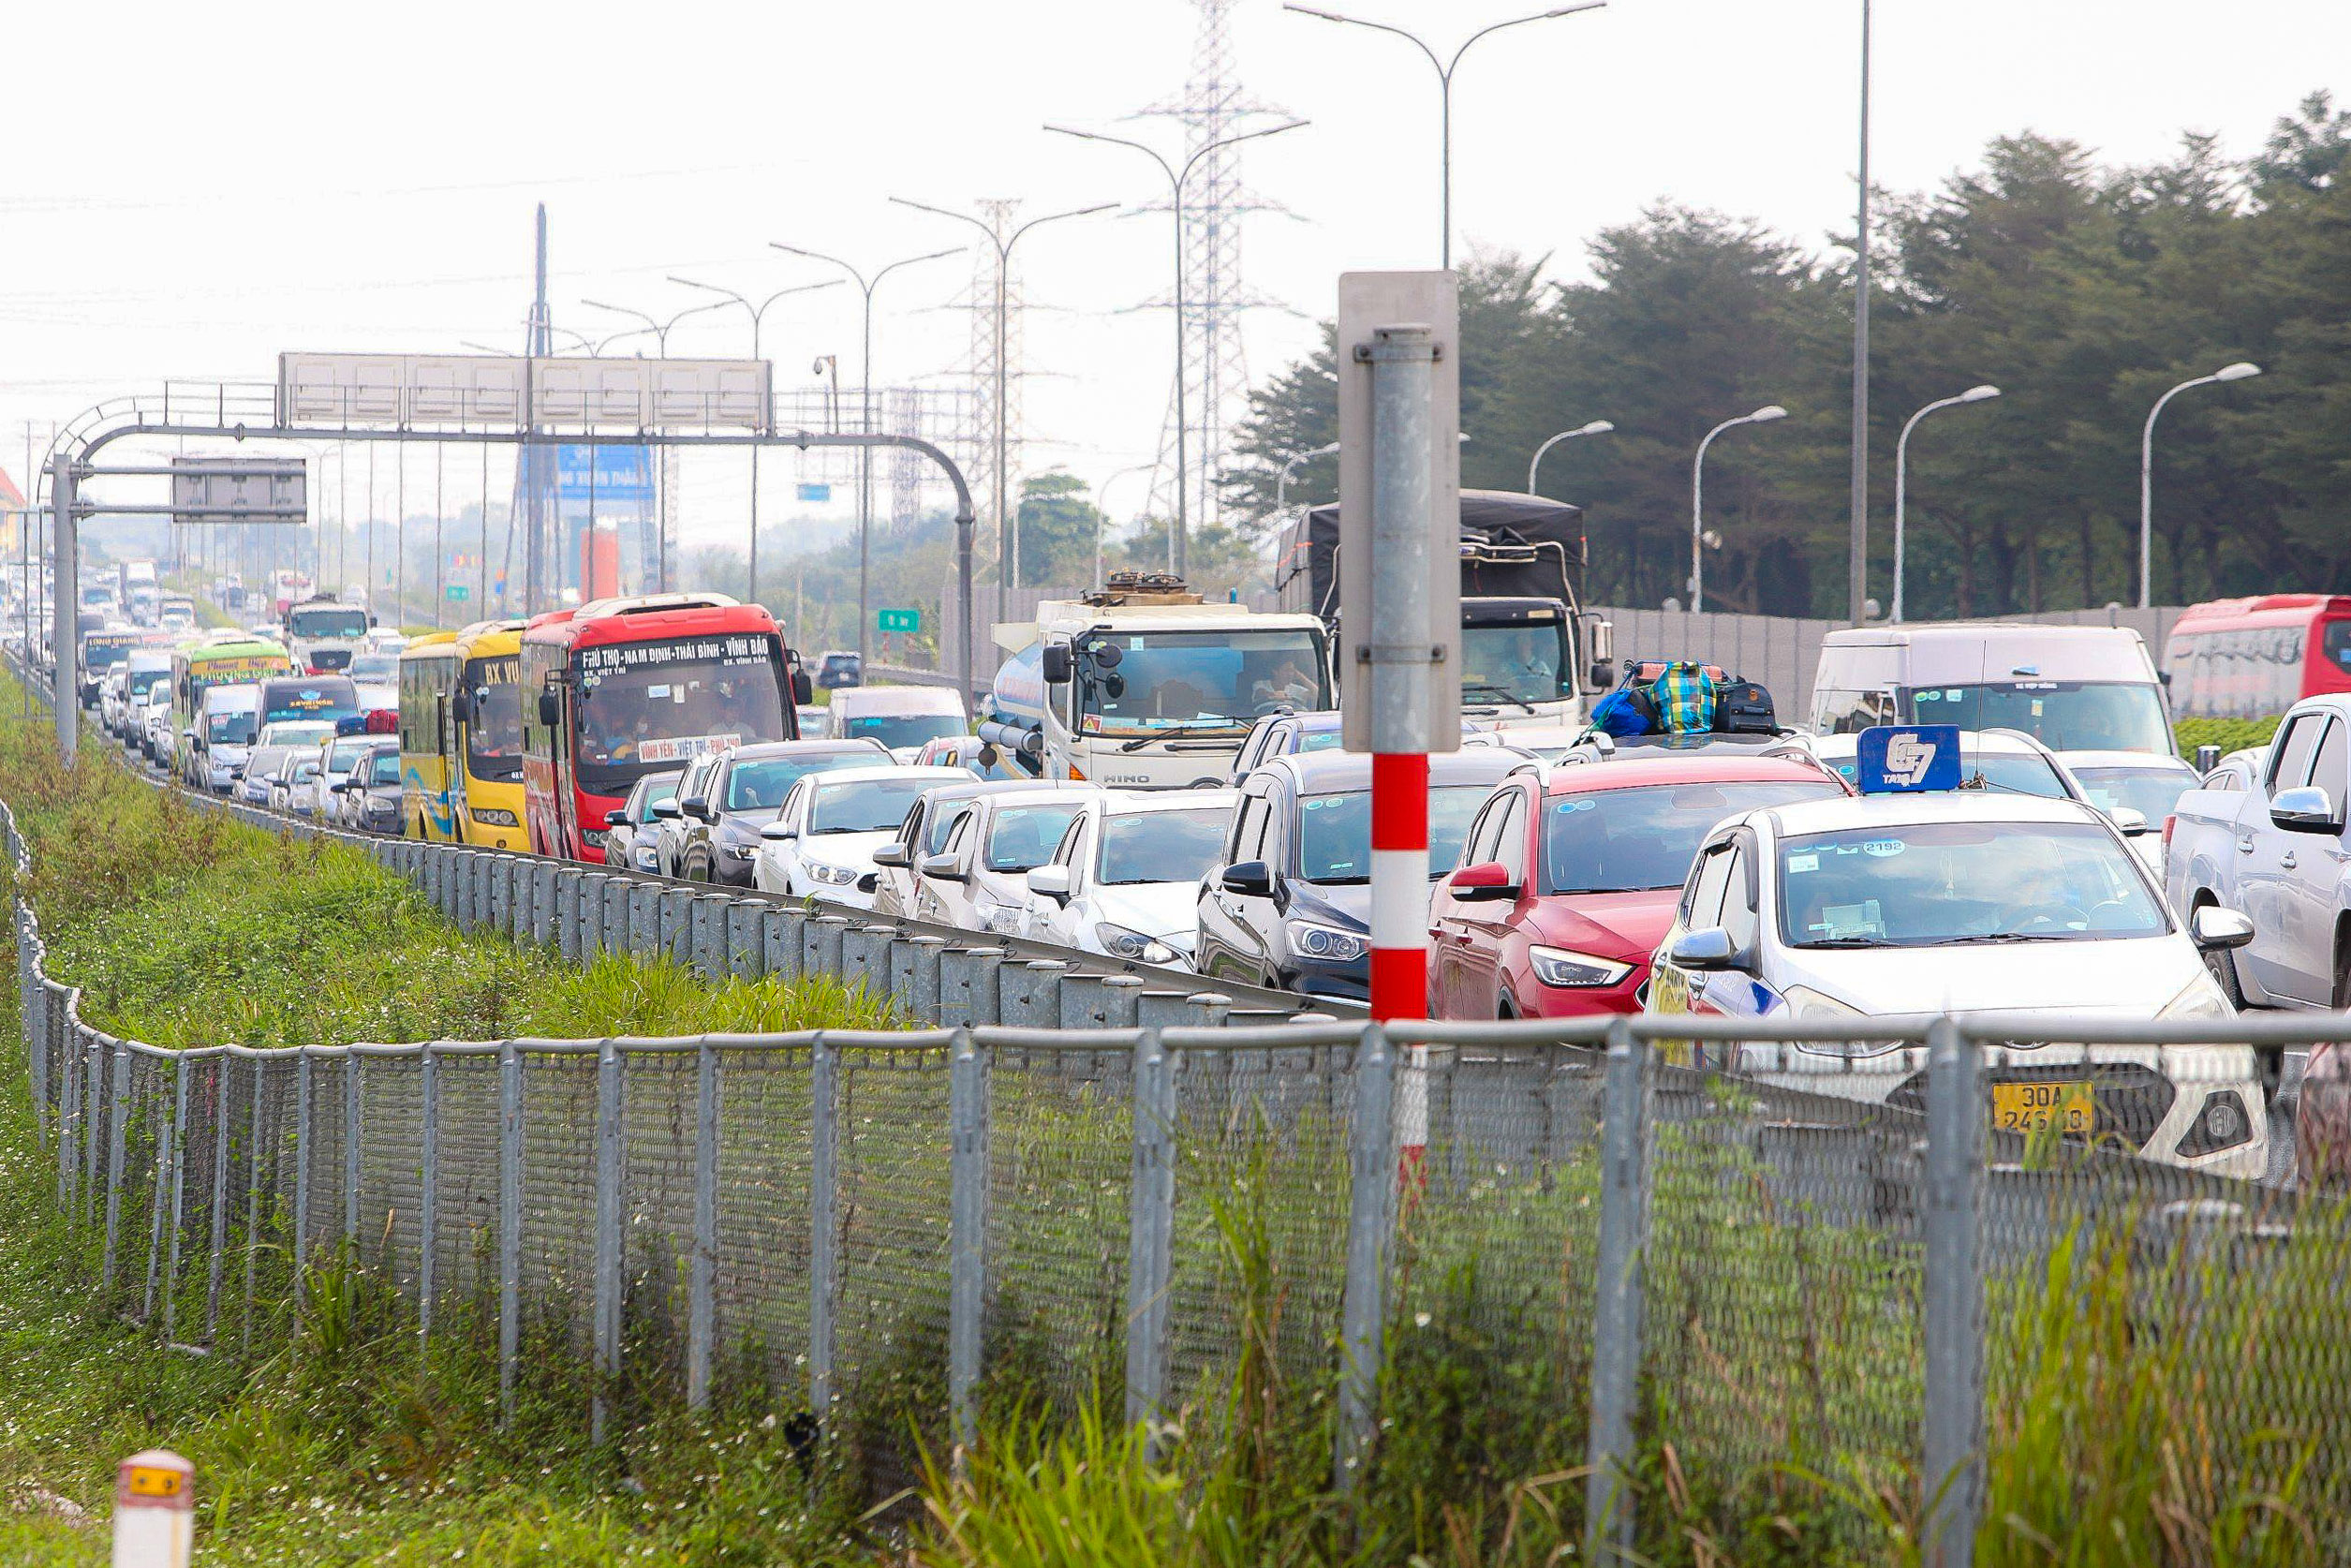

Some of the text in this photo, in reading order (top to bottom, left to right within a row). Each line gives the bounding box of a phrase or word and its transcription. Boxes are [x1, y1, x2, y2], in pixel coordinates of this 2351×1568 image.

[485, 662, 502, 685] BX
[1885, 732, 1937, 784] G7
[1104, 775, 1150, 783] HINO
[1866, 841, 1903, 851] 2192
[2022, 1086, 2062, 1108] 30A
